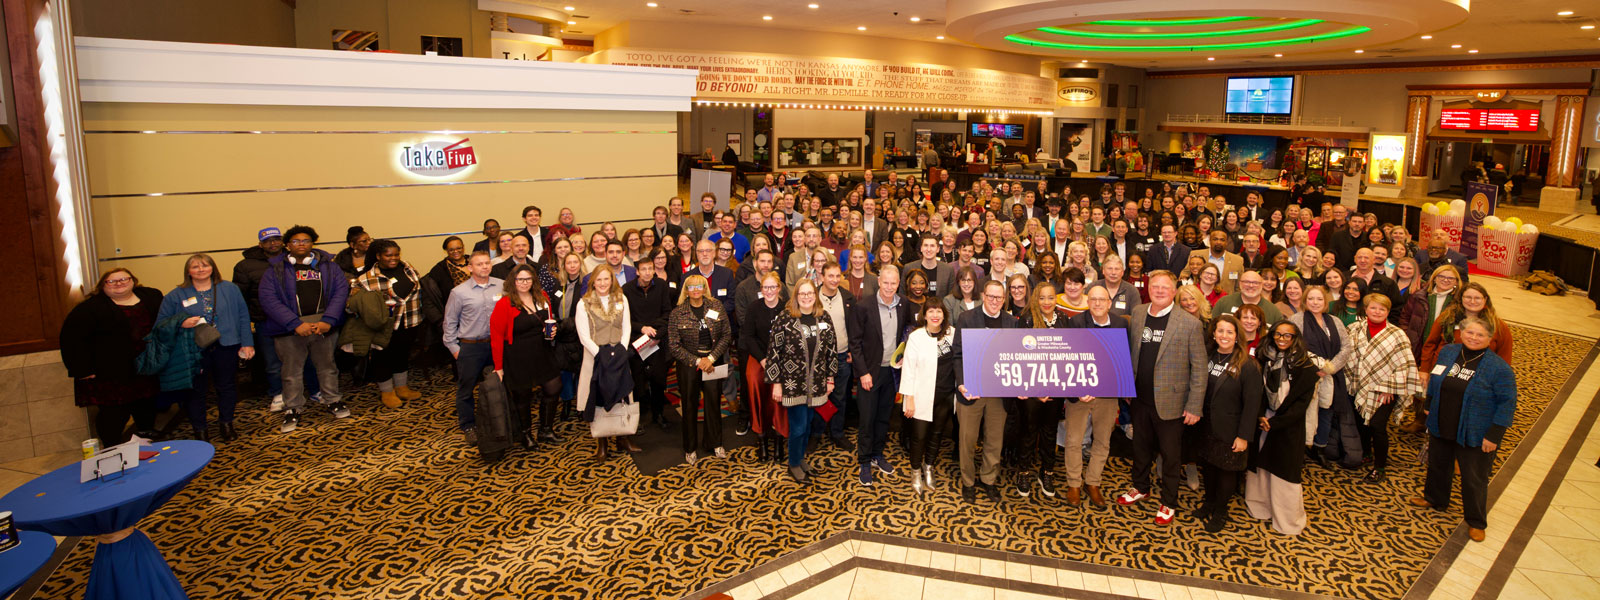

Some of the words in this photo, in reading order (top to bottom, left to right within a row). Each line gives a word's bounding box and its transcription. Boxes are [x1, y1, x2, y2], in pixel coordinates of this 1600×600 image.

[626, 53, 655, 62] TOTO,
[658, 54, 673, 62] I'VE
[676, 55, 696, 63] GOT
[708, 56, 745, 65] FEELING
[747, 58, 772, 66] WE'RE
[808, 61, 839, 70] KANSAS
[765, 66, 793, 75] HERE'S
[794, 67, 829, 77] LOOKING
[889, 65, 900, 73] YOU
[900, 66, 915, 74] BUILD
[699, 73, 719, 81] GOING
[733, 74, 752, 82] DON'T
[754, 75, 769, 83] NEED
[795, 76, 805, 84] MAY
[806, 76, 815, 85] THE
[815, 76, 827, 85] FORCE
[710, 82, 758, 93] BEYOND!
[874, 79, 905, 89] PHONE
[763, 86, 780, 94] ALL
[871, 89, 883, 98] I'M
[884, 90, 910, 98] READY
[910, 91, 924, 99] FOR
[926, 92, 937, 100] MY
[403, 146, 444, 167] Take
[448, 151, 473, 166] Five
[1483, 240, 1507, 252] POP
[999, 352, 1014, 361] 2024
[1014, 352, 1049, 361] COMMUNITY
[1049, 352, 1079, 361] CAMPAIGN
[1079, 352, 1096, 361] TOTAL
[993, 361, 1099, 391] $59,744,243
